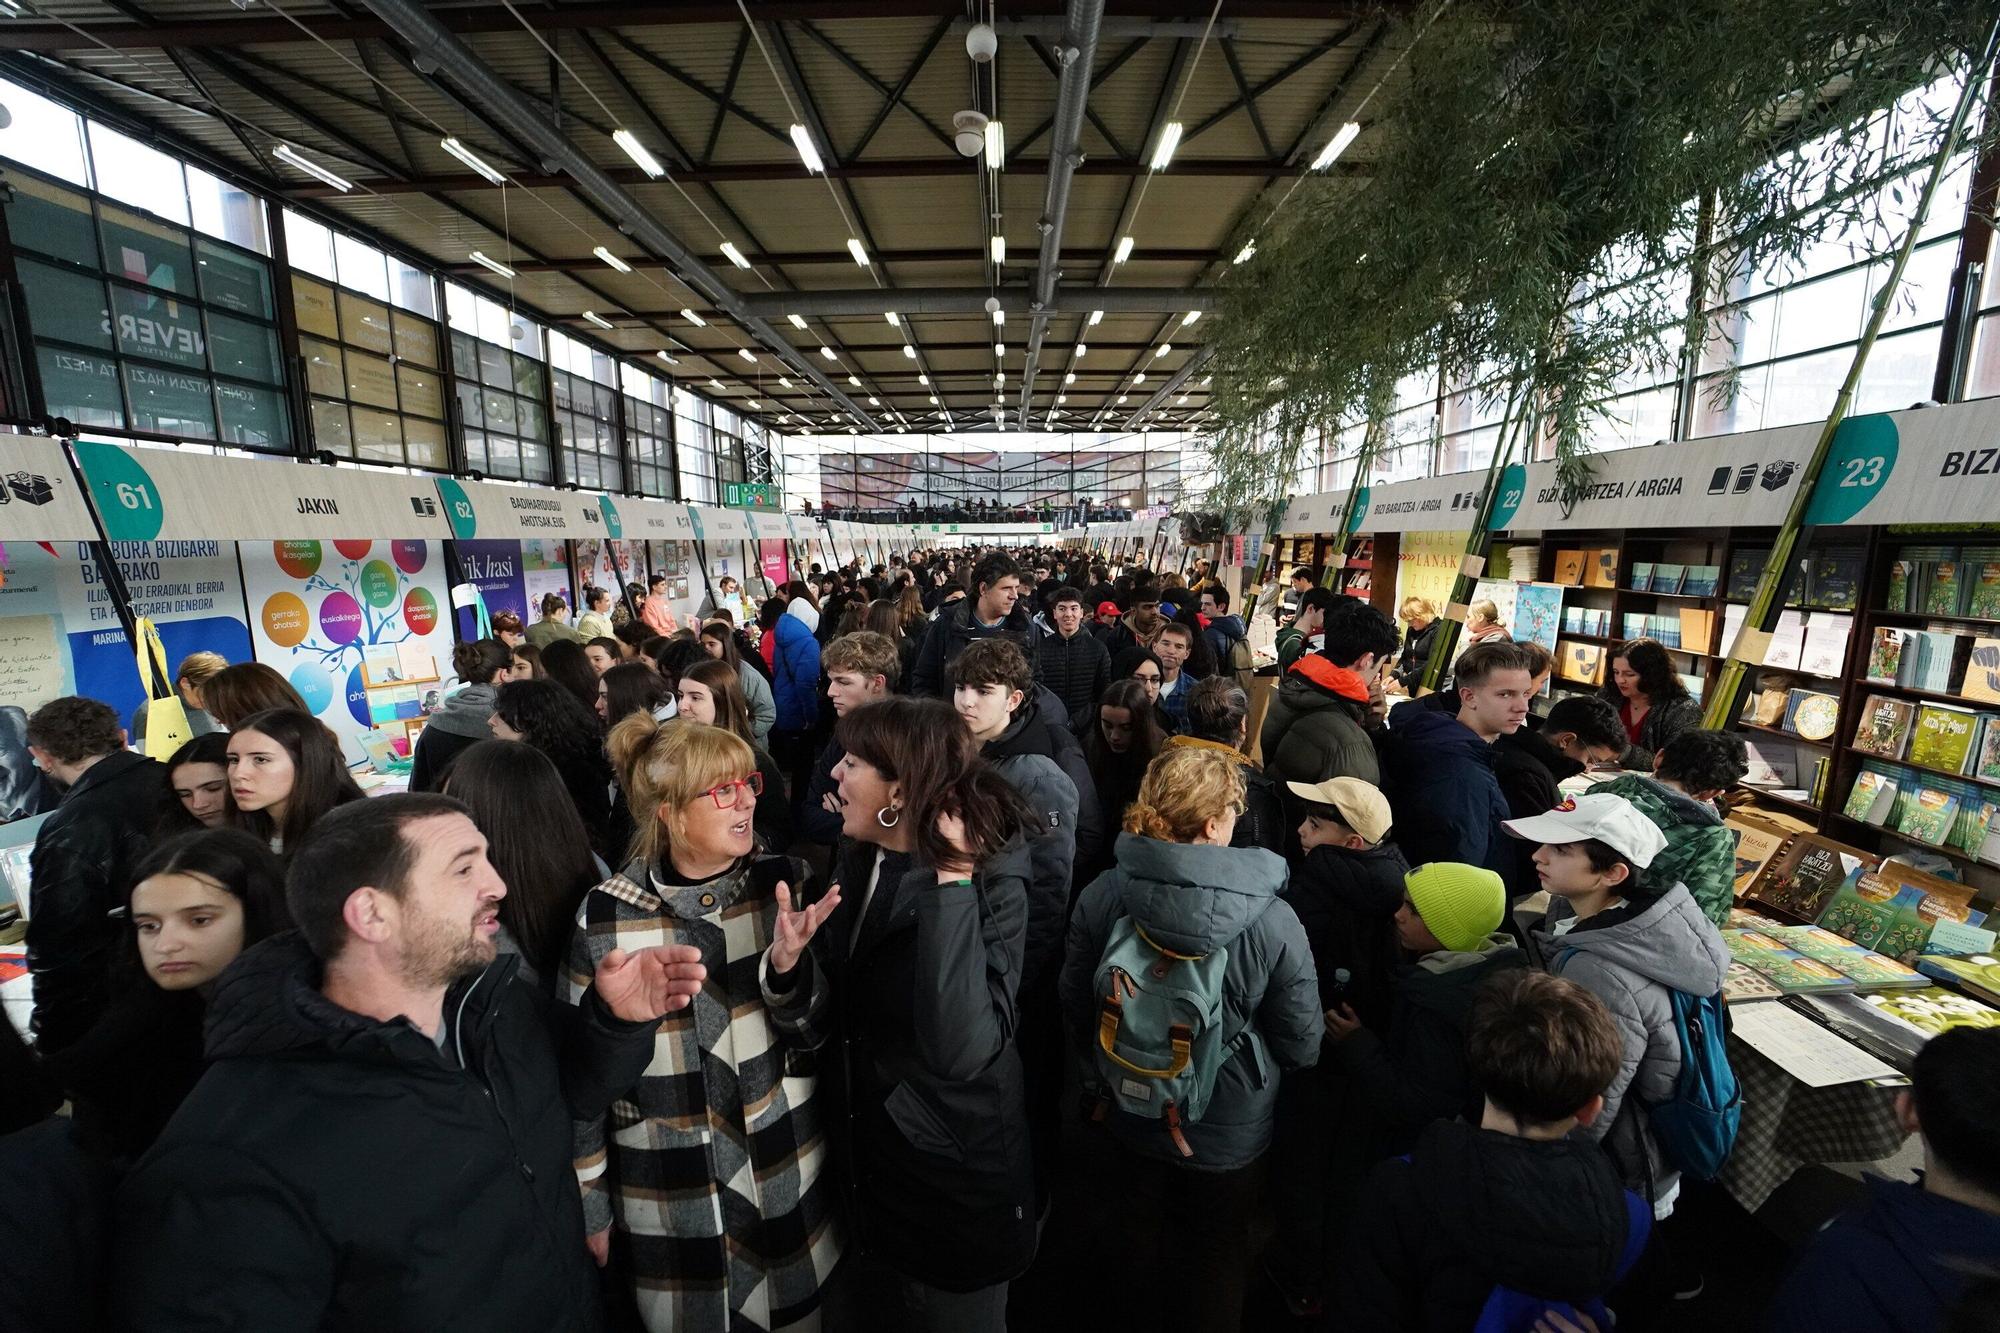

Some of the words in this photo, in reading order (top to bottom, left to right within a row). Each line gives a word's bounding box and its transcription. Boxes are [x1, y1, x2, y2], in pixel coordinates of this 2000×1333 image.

[1840, 456, 1885, 488] 23
[117, 483, 153, 510] 61
[728, 485, 740, 504] 01
[1503, 490, 1521, 508] 22
[1537, 487, 1560, 503] BIZI
[1635, 477, 1683, 497] ARGIA
[297, 497, 339, 515] JAKIN
[455, 502, 473, 518] 62
[1357, 505, 1366, 517] 21
[1374, 504, 1385, 515] BIZI
[1385, 501, 1416, 514] BARATZEA
[1420, 499, 1442, 511] ARGIA
[519, 515, 566, 528] AHOTSAK.EUS
[156, 541, 219, 559] BIZIGARRI
[486, 554, 513, 578] hasi
[1416, 553, 1457, 568] LANAK
[0, 585, 38, 594] zurmendi
[146, 582, 193, 598] ERRADIKAL
[197, 581, 225, 594] BERRIA
[1411, 574, 1451, 593] ZURE
[90, 607, 107, 620] ETA
[175, 598, 214, 613] DENBORA
[93, 632, 127, 646] MARINA
[349, 691, 366, 702] aho
[1802, 854, 1834, 873] BARATZEA
[1815, 849, 1831, 861] BIZI
